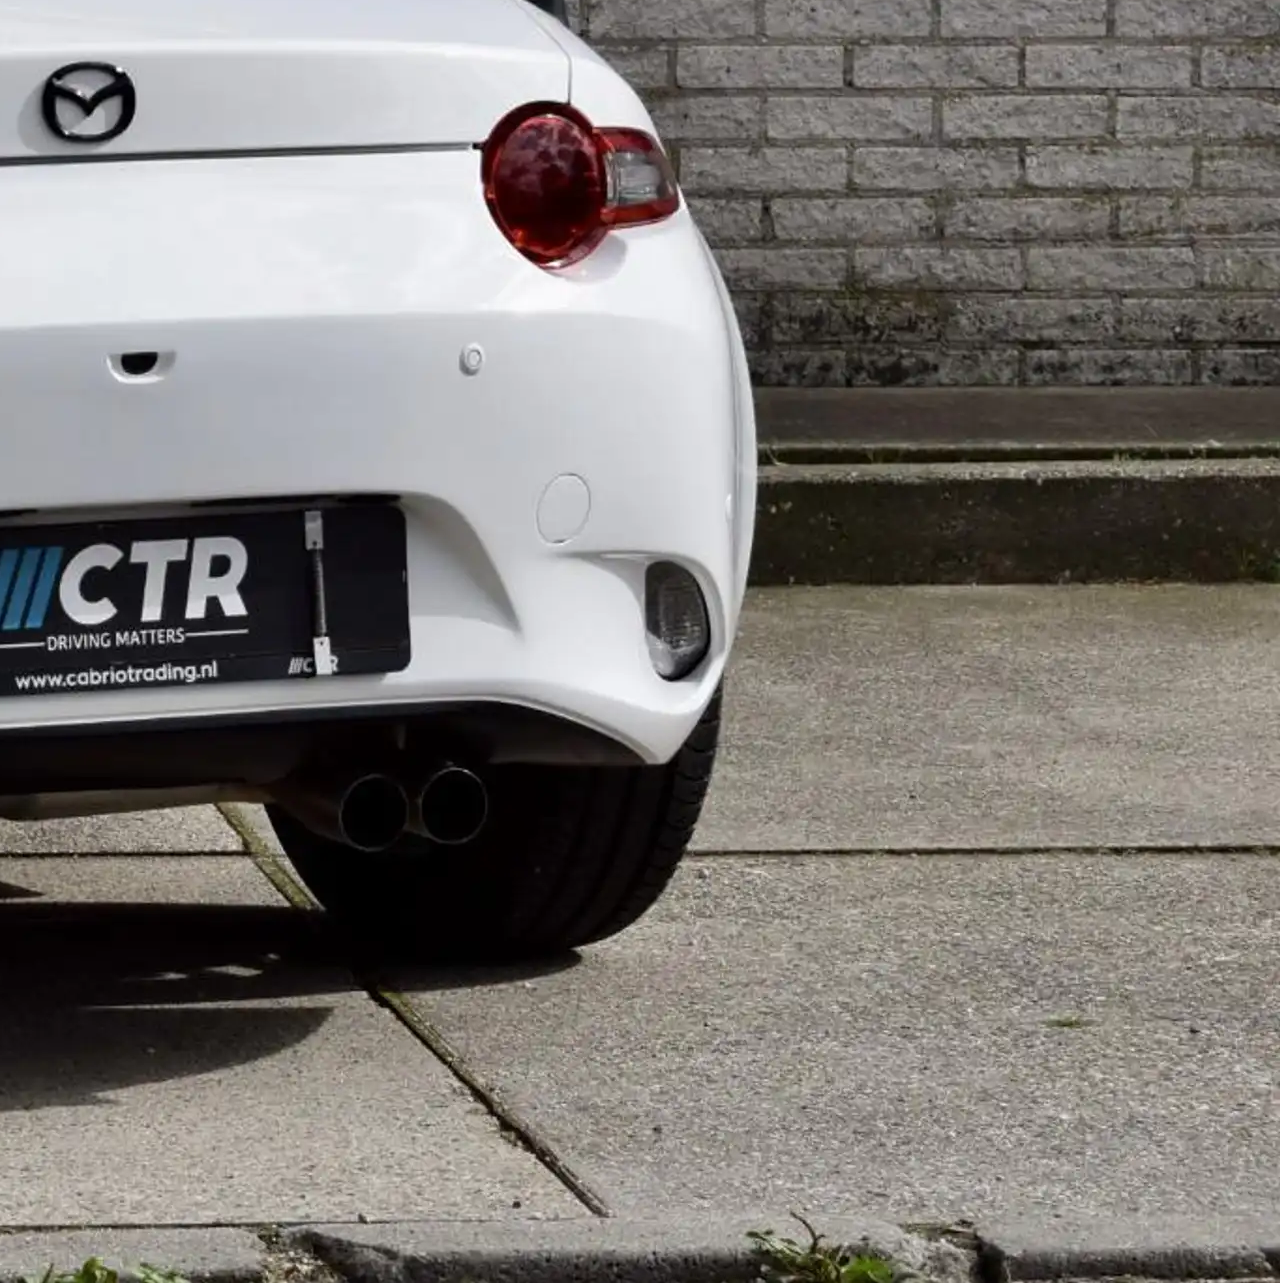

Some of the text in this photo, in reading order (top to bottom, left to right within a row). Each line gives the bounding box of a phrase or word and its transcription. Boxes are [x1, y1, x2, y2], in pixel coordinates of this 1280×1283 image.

[57, 535, 249, 626] CTR
[46, 627, 186, 652] DRIVING MATTERS
[14, 660, 219, 692] www.cabriotrading.nl
